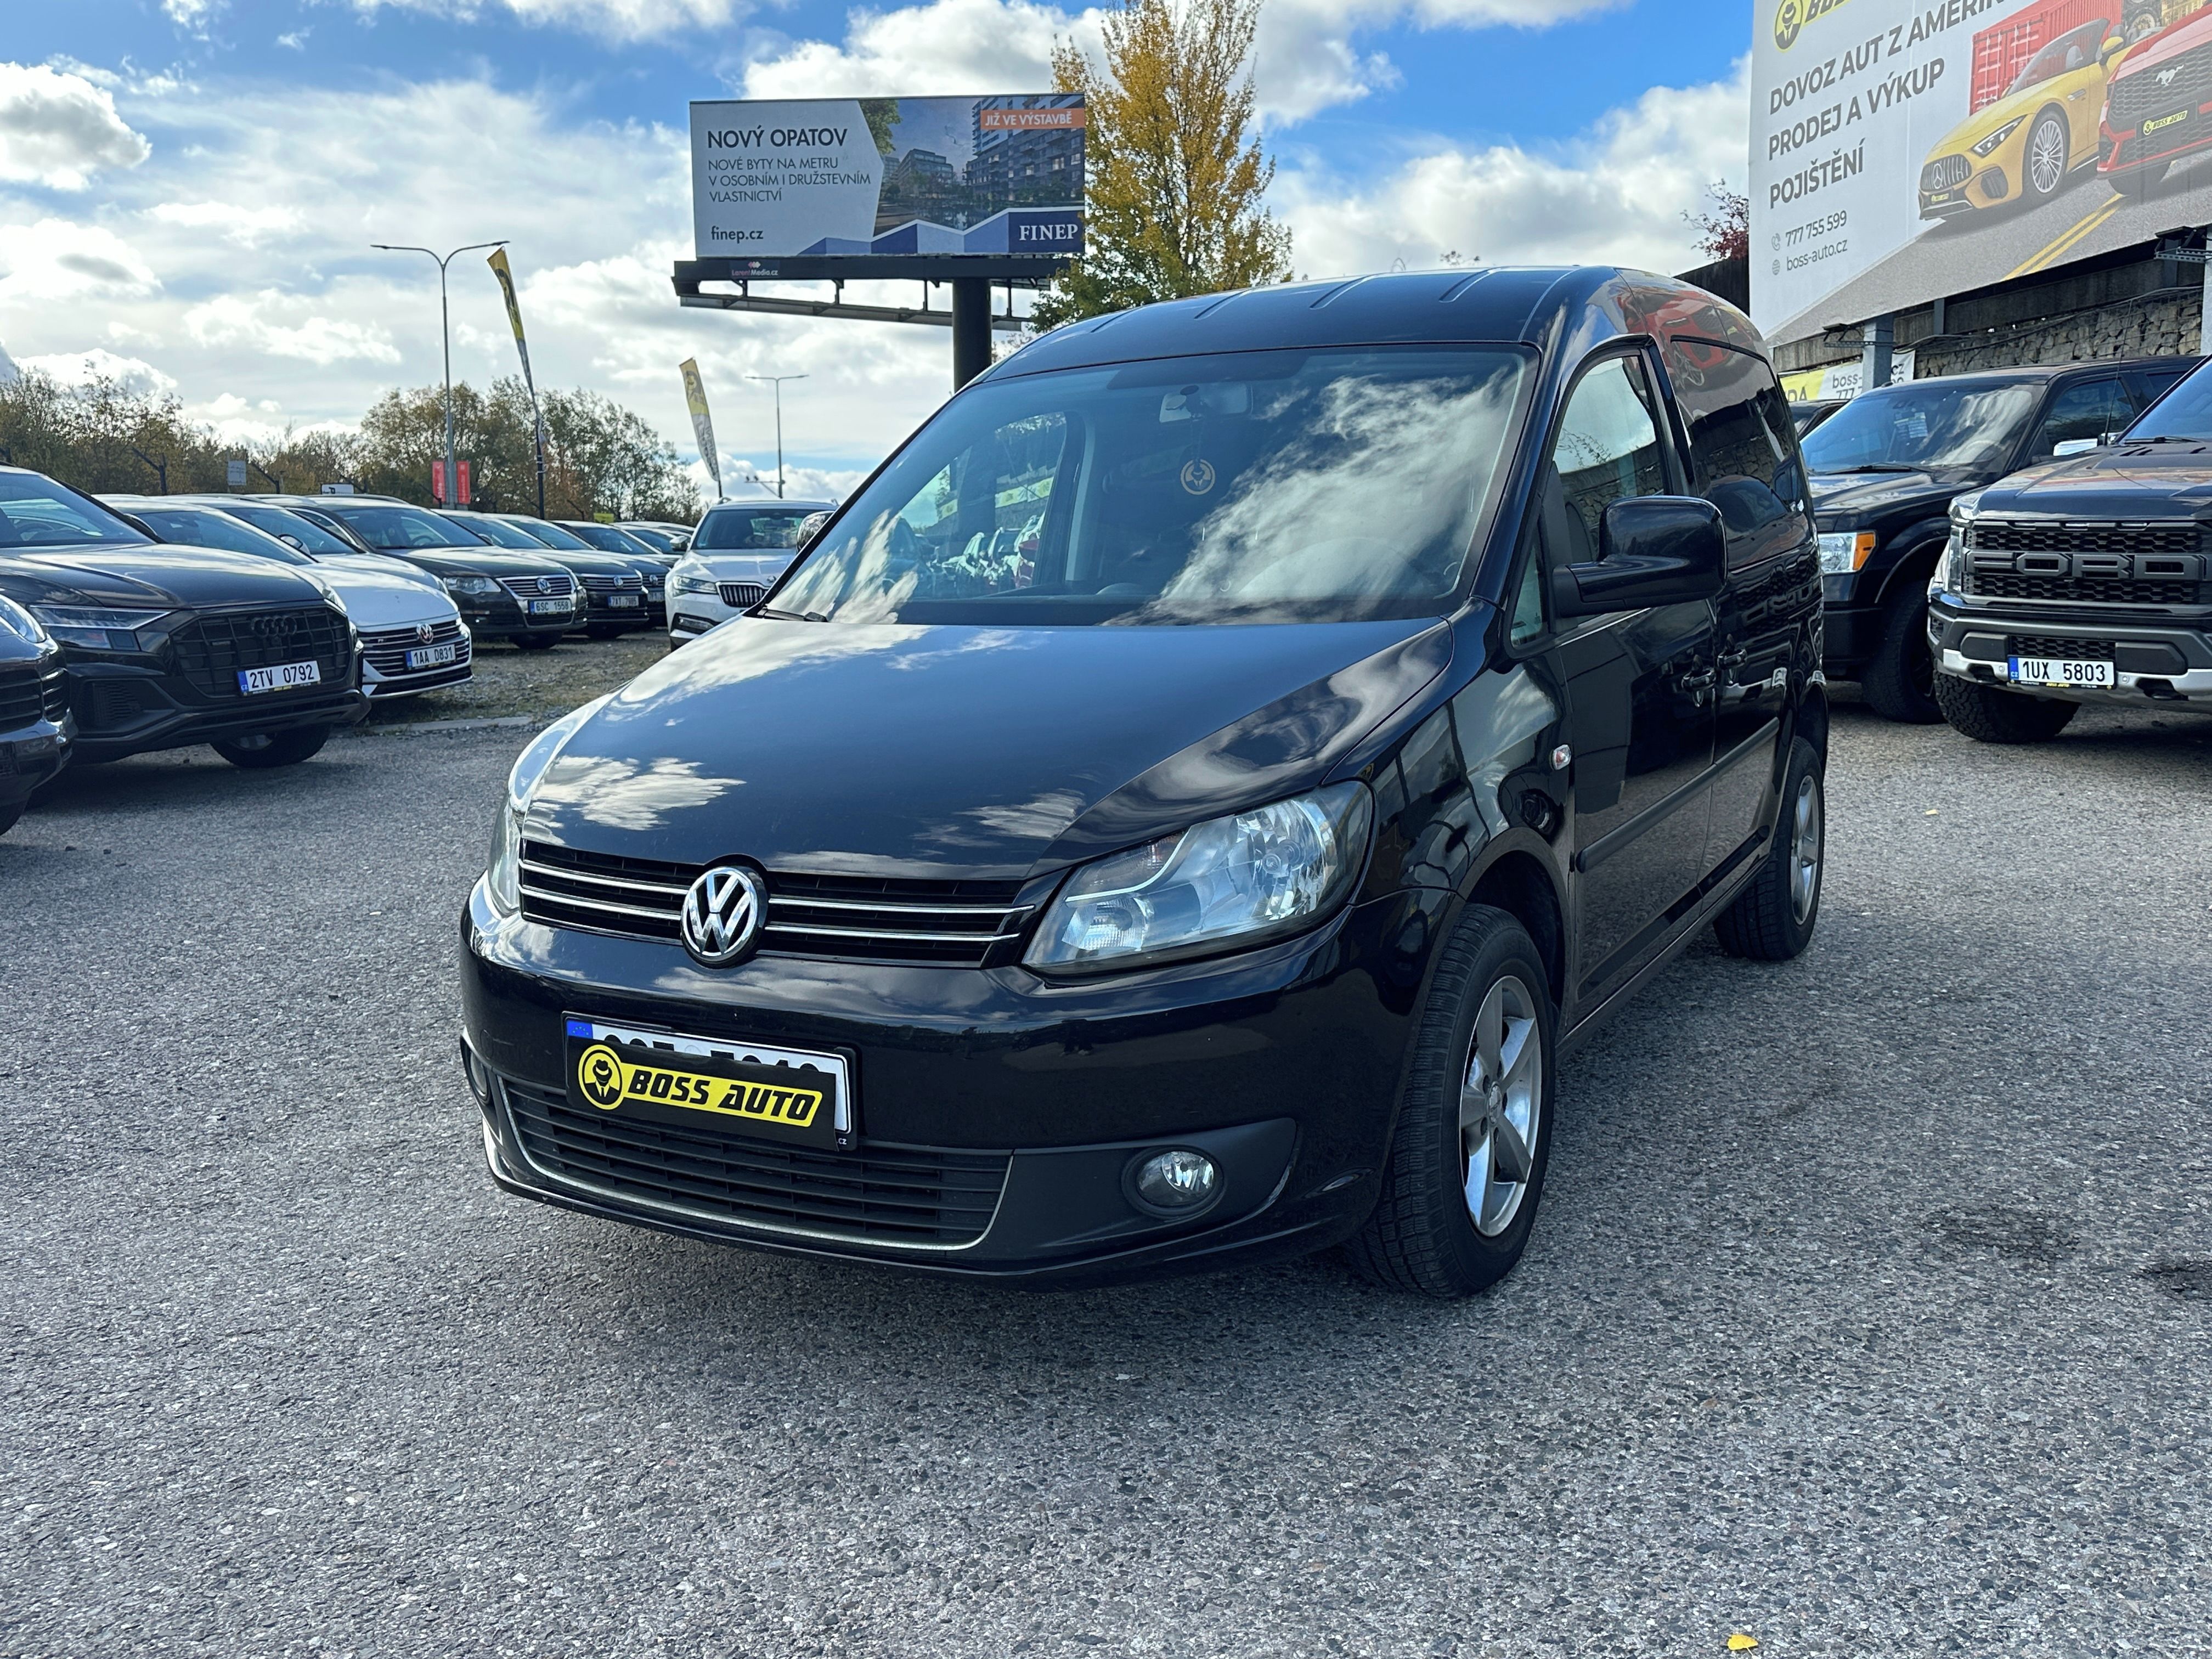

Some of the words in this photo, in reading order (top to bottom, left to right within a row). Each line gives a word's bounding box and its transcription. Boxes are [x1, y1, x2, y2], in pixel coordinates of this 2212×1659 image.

[1770, 58, 1836, 115] DOVOZ
[1839, 34, 1883, 80] AUT
[1888, 25, 1903, 57] Z
[1906, 0, 2004, 48] AMER
[985, 112, 1000, 126] JIŽ
[1003, 115, 1017, 125] VE
[1019, 111, 1073, 125] VÝSTAVBĚ
[1769, 103, 1842, 161] PRODEJ
[1846, 96, 1862, 126] A
[1867, 58, 1944, 114] VÝKUP
[708, 125, 765, 148] NOVÝ
[770, 128, 848, 147] OPATOV
[708, 156, 743, 171] NOVÉ
[747, 159, 773, 170] BYTY
[777, 158, 797, 169] NA
[799, 157, 838, 169] METRU
[1770, 138, 1865, 209] POJIŠTĚNÍ
[709, 176, 717, 186] V
[720, 172, 778, 186] OSOBNÍM
[782, 174, 785, 185] I
[789, 171, 871, 185] DRUŽSTEVNÍM
[709, 188, 782, 202] VLASTNICTVÍ
[711, 225, 764, 244] finep.cz
[1019, 224, 1078, 240] FINEP
[1785, 227, 1803, 246] 777
[1805, 218, 1824, 239] 755
[1827, 210, 1847, 231] 599
[1787, 240, 1848, 271] boss-auto.cz
[1786, 386, 1808, 402] DA
[1962, 549, 2207, 580] FORD
[414, 651, 430, 665] 1AA
[250, 669, 273, 689] 2TV
[283, 664, 314, 684] 0792
[2023, 661, 2050, 680] 1UX
[2063, 663, 2106, 682] 5803
[628, 1069, 712, 1104] BOSS
[718, 1084, 816, 1121] AUTO
